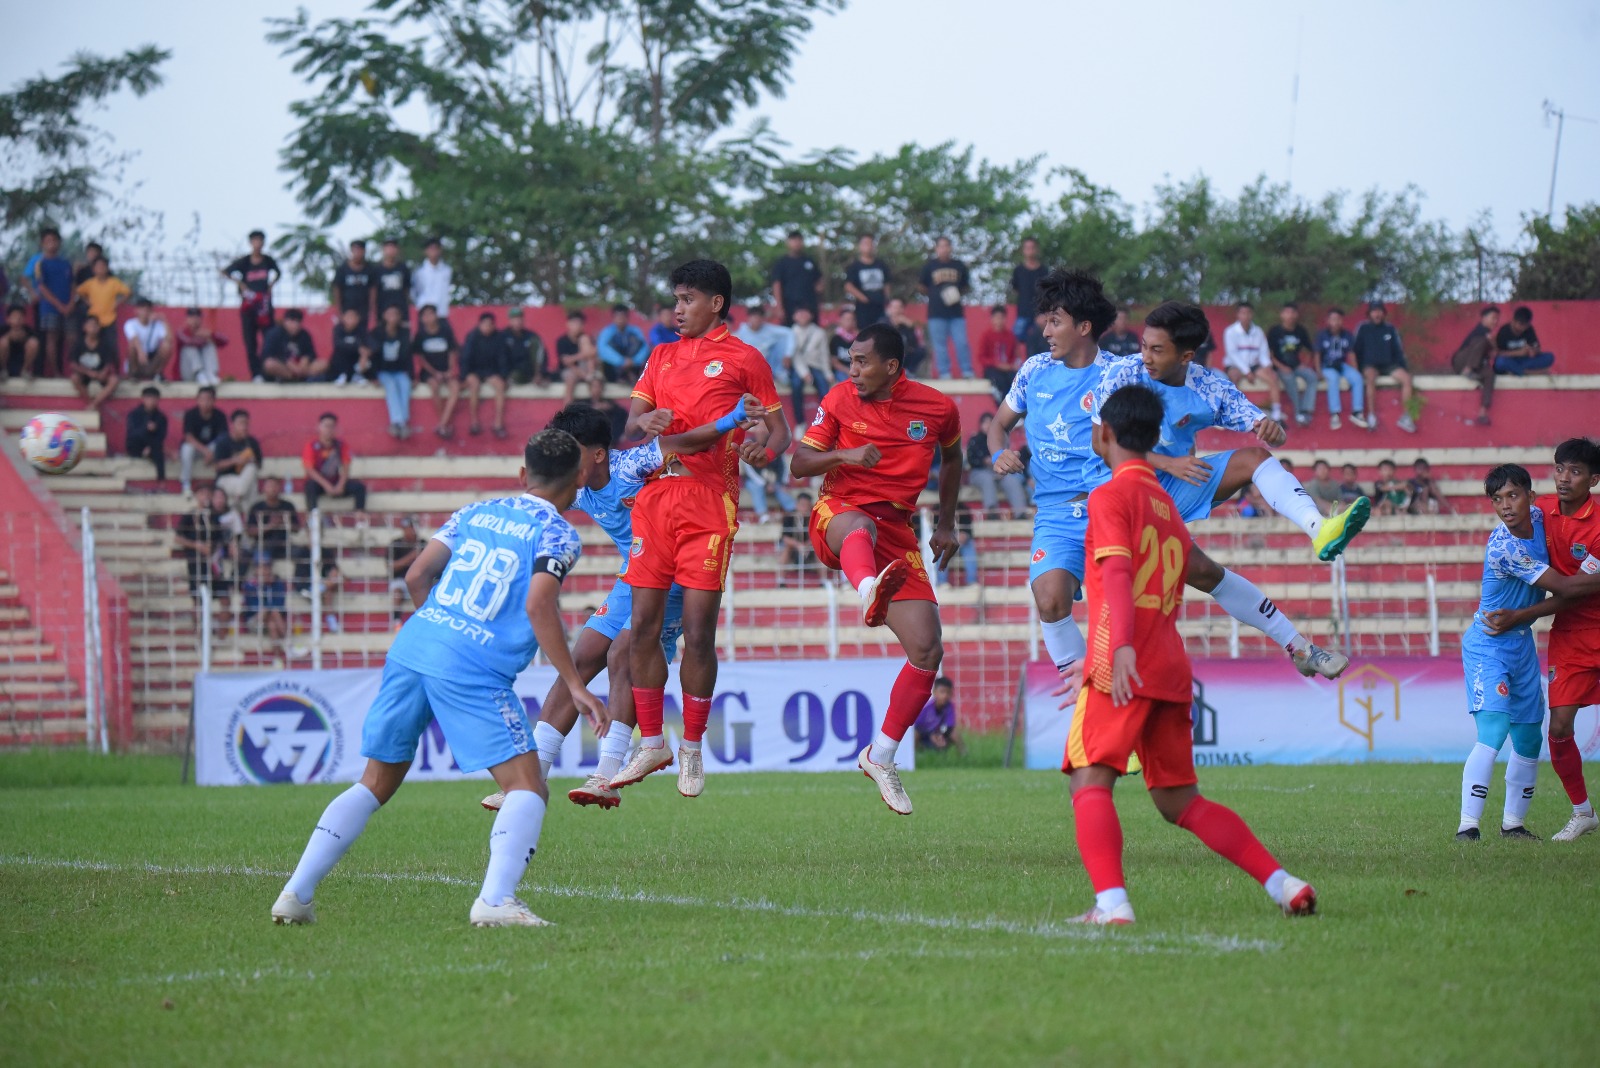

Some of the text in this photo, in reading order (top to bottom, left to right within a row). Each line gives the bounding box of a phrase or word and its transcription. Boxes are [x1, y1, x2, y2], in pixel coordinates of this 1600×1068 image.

[1149, 495, 1171, 522] YOGI
[434, 538, 521, 623] 28
[546, 557, 563, 578] C
[782, 689, 875, 764] 99
